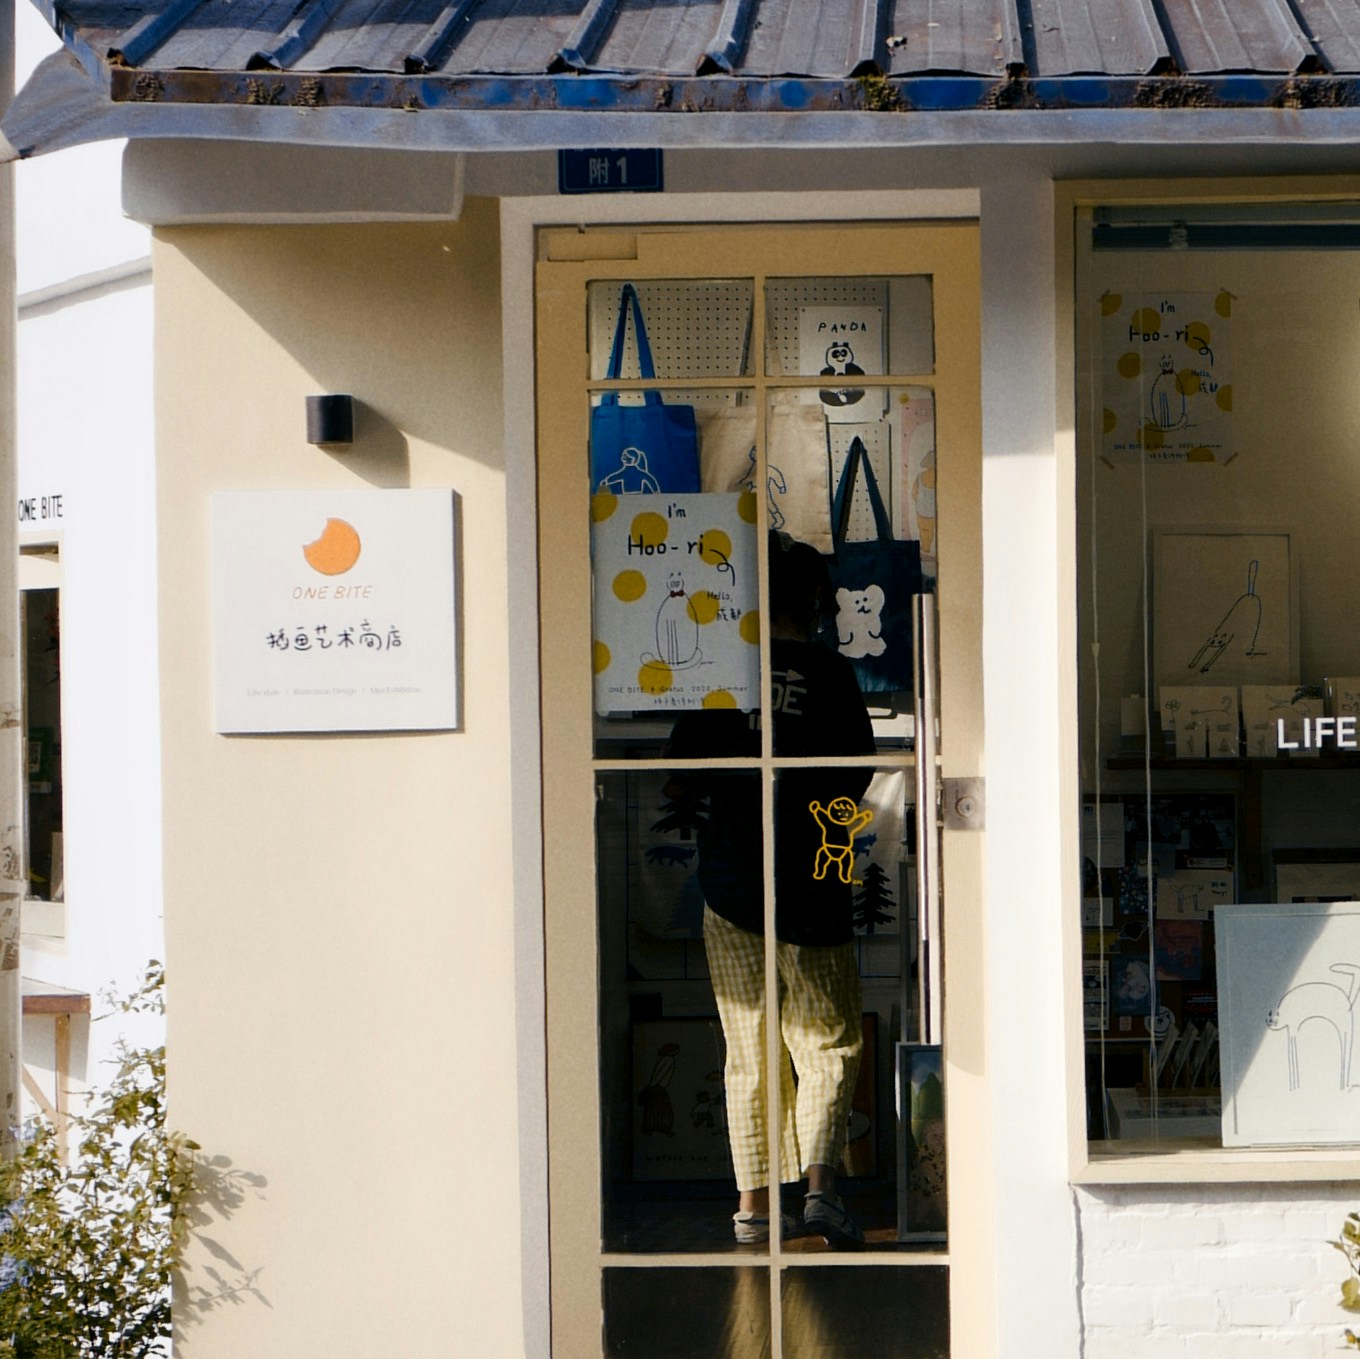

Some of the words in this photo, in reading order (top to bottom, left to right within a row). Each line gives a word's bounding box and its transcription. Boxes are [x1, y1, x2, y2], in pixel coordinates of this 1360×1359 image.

[18, 497, 37, 522] ONE
[41, 494, 63, 519] BITE
[667, 502, 687, 518] I'm
[292, 585, 330, 600] ONE
[333, 585, 373, 600] BITE
[1276, 716, 1358, 750] LIFE
